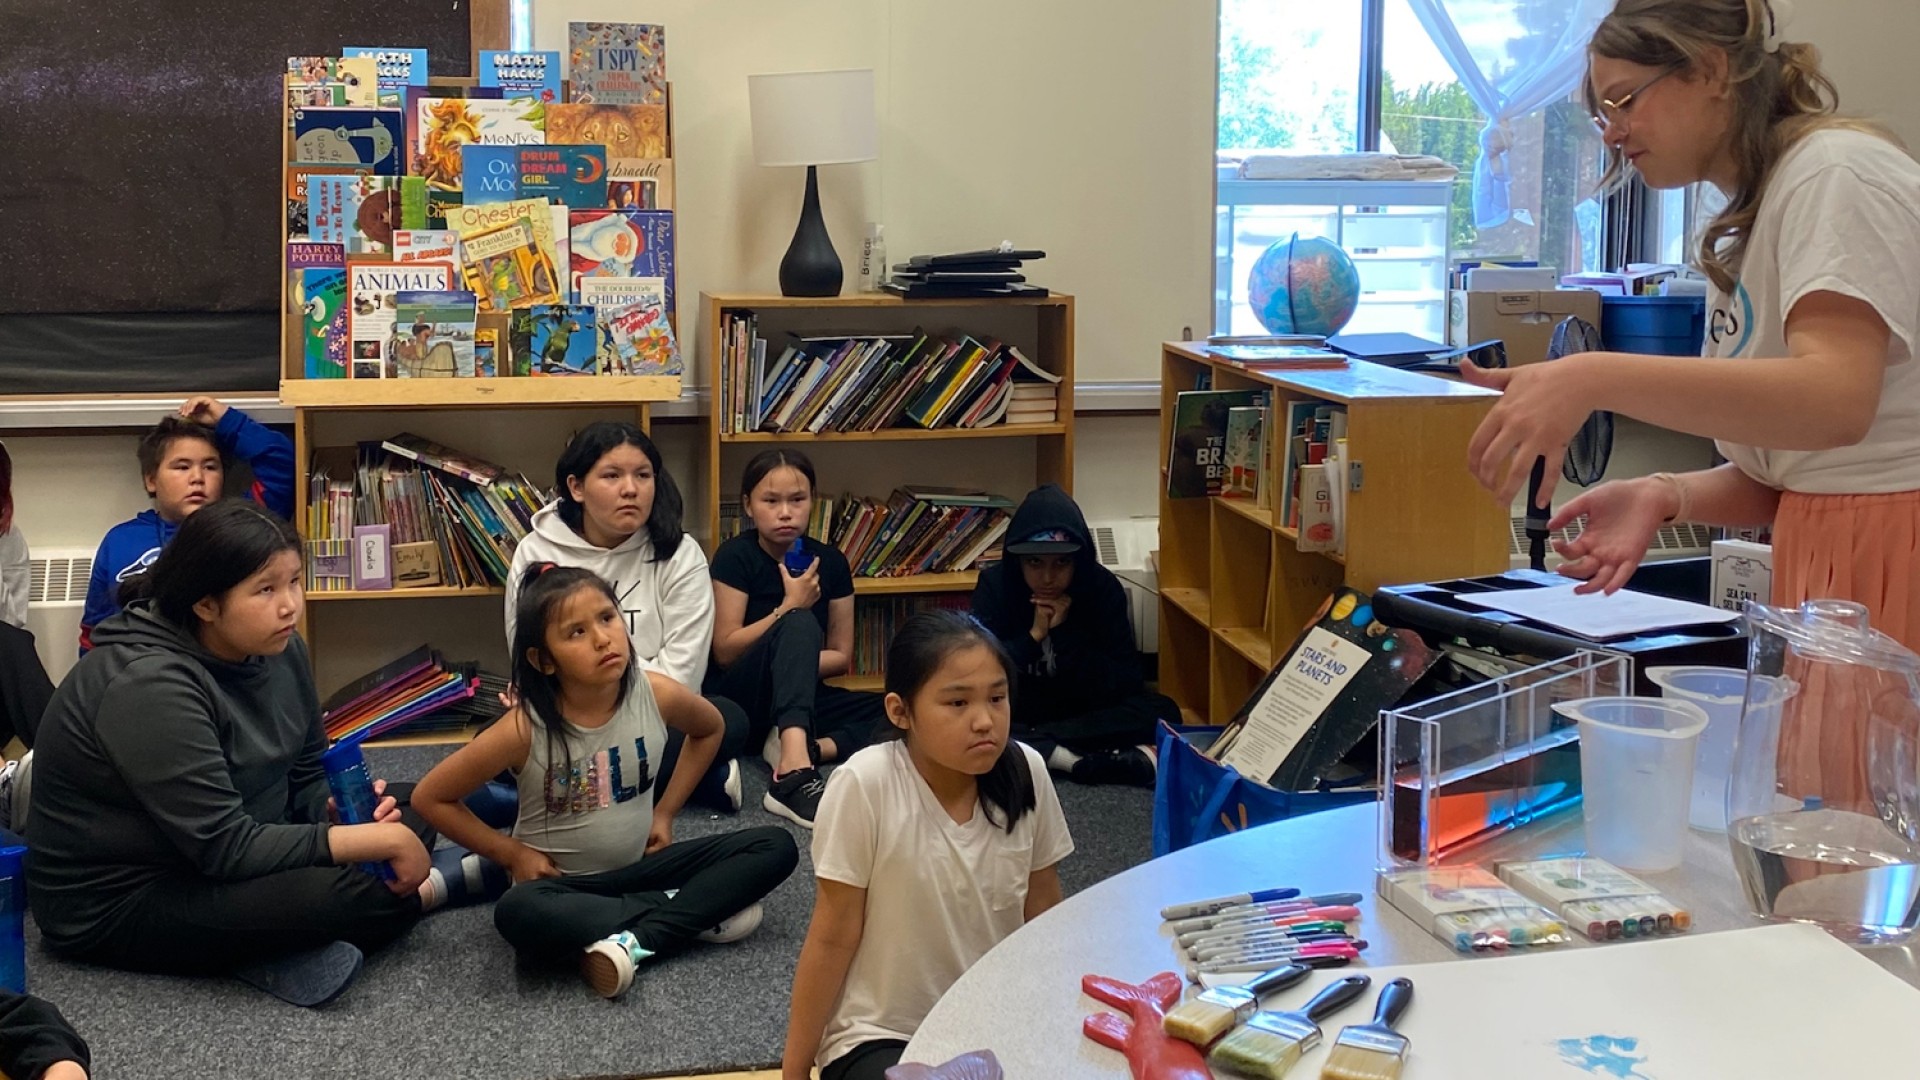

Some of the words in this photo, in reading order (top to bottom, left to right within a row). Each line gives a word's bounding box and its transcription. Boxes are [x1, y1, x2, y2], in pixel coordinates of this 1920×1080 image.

[359, 51, 412, 64] MATH
[493, 53, 547, 67] MATH
[598, 48, 604, 70] I
[609, 48, 638, 71] SPY
[498, 68, 545, 81] HACKS
[304, 141, 313, 161] Let
[520, 151, 560, 161] DRUM
[520, 163, 568, 174] DREAM
[612, 161, 662, 177] bracelet
[522, 174, 549, 184] GIRL
[462, 202, 536, 226] Chester
[477, 230, 514, 249] Franklin
[292, 244, 340, 254] HARRY
[291, 253, 342, 262] POTTER
[354, 273, 446, 291] ANIMALS
[1206, 436, 1225, 447] THE
[395, 547, 425, 564] Emily
[1726, 587, 1739, 599] SEA
[1300, 646, 1327, 665] STARS
[1323, 659, 1348, 676] AND
[1295, 660, 1335, 686] PLANETS
